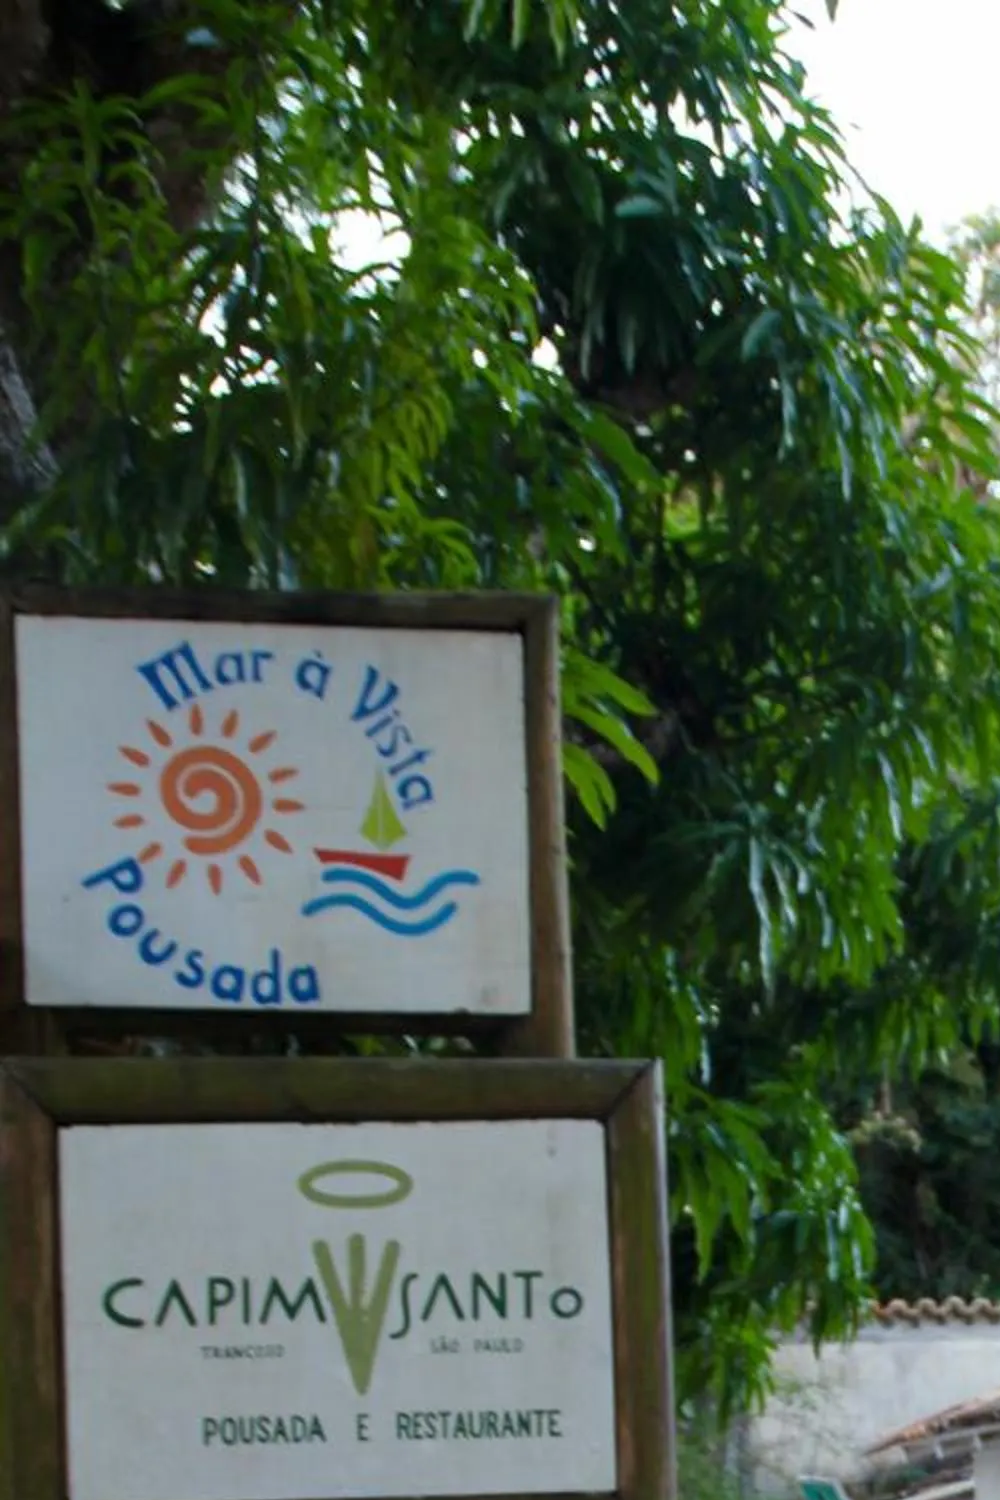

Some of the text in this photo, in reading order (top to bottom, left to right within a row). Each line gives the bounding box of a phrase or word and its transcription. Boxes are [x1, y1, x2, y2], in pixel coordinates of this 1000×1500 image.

[136, 640, 276, 712] Mar
[350, 664, 437, 810] Vista
[81, 856, 322, 1003] Pousada
[103, 1271, 584, 1339] CAPIM SANTO
[202, 1408, 563, 1447] POUSADA E RESTAURANTE
